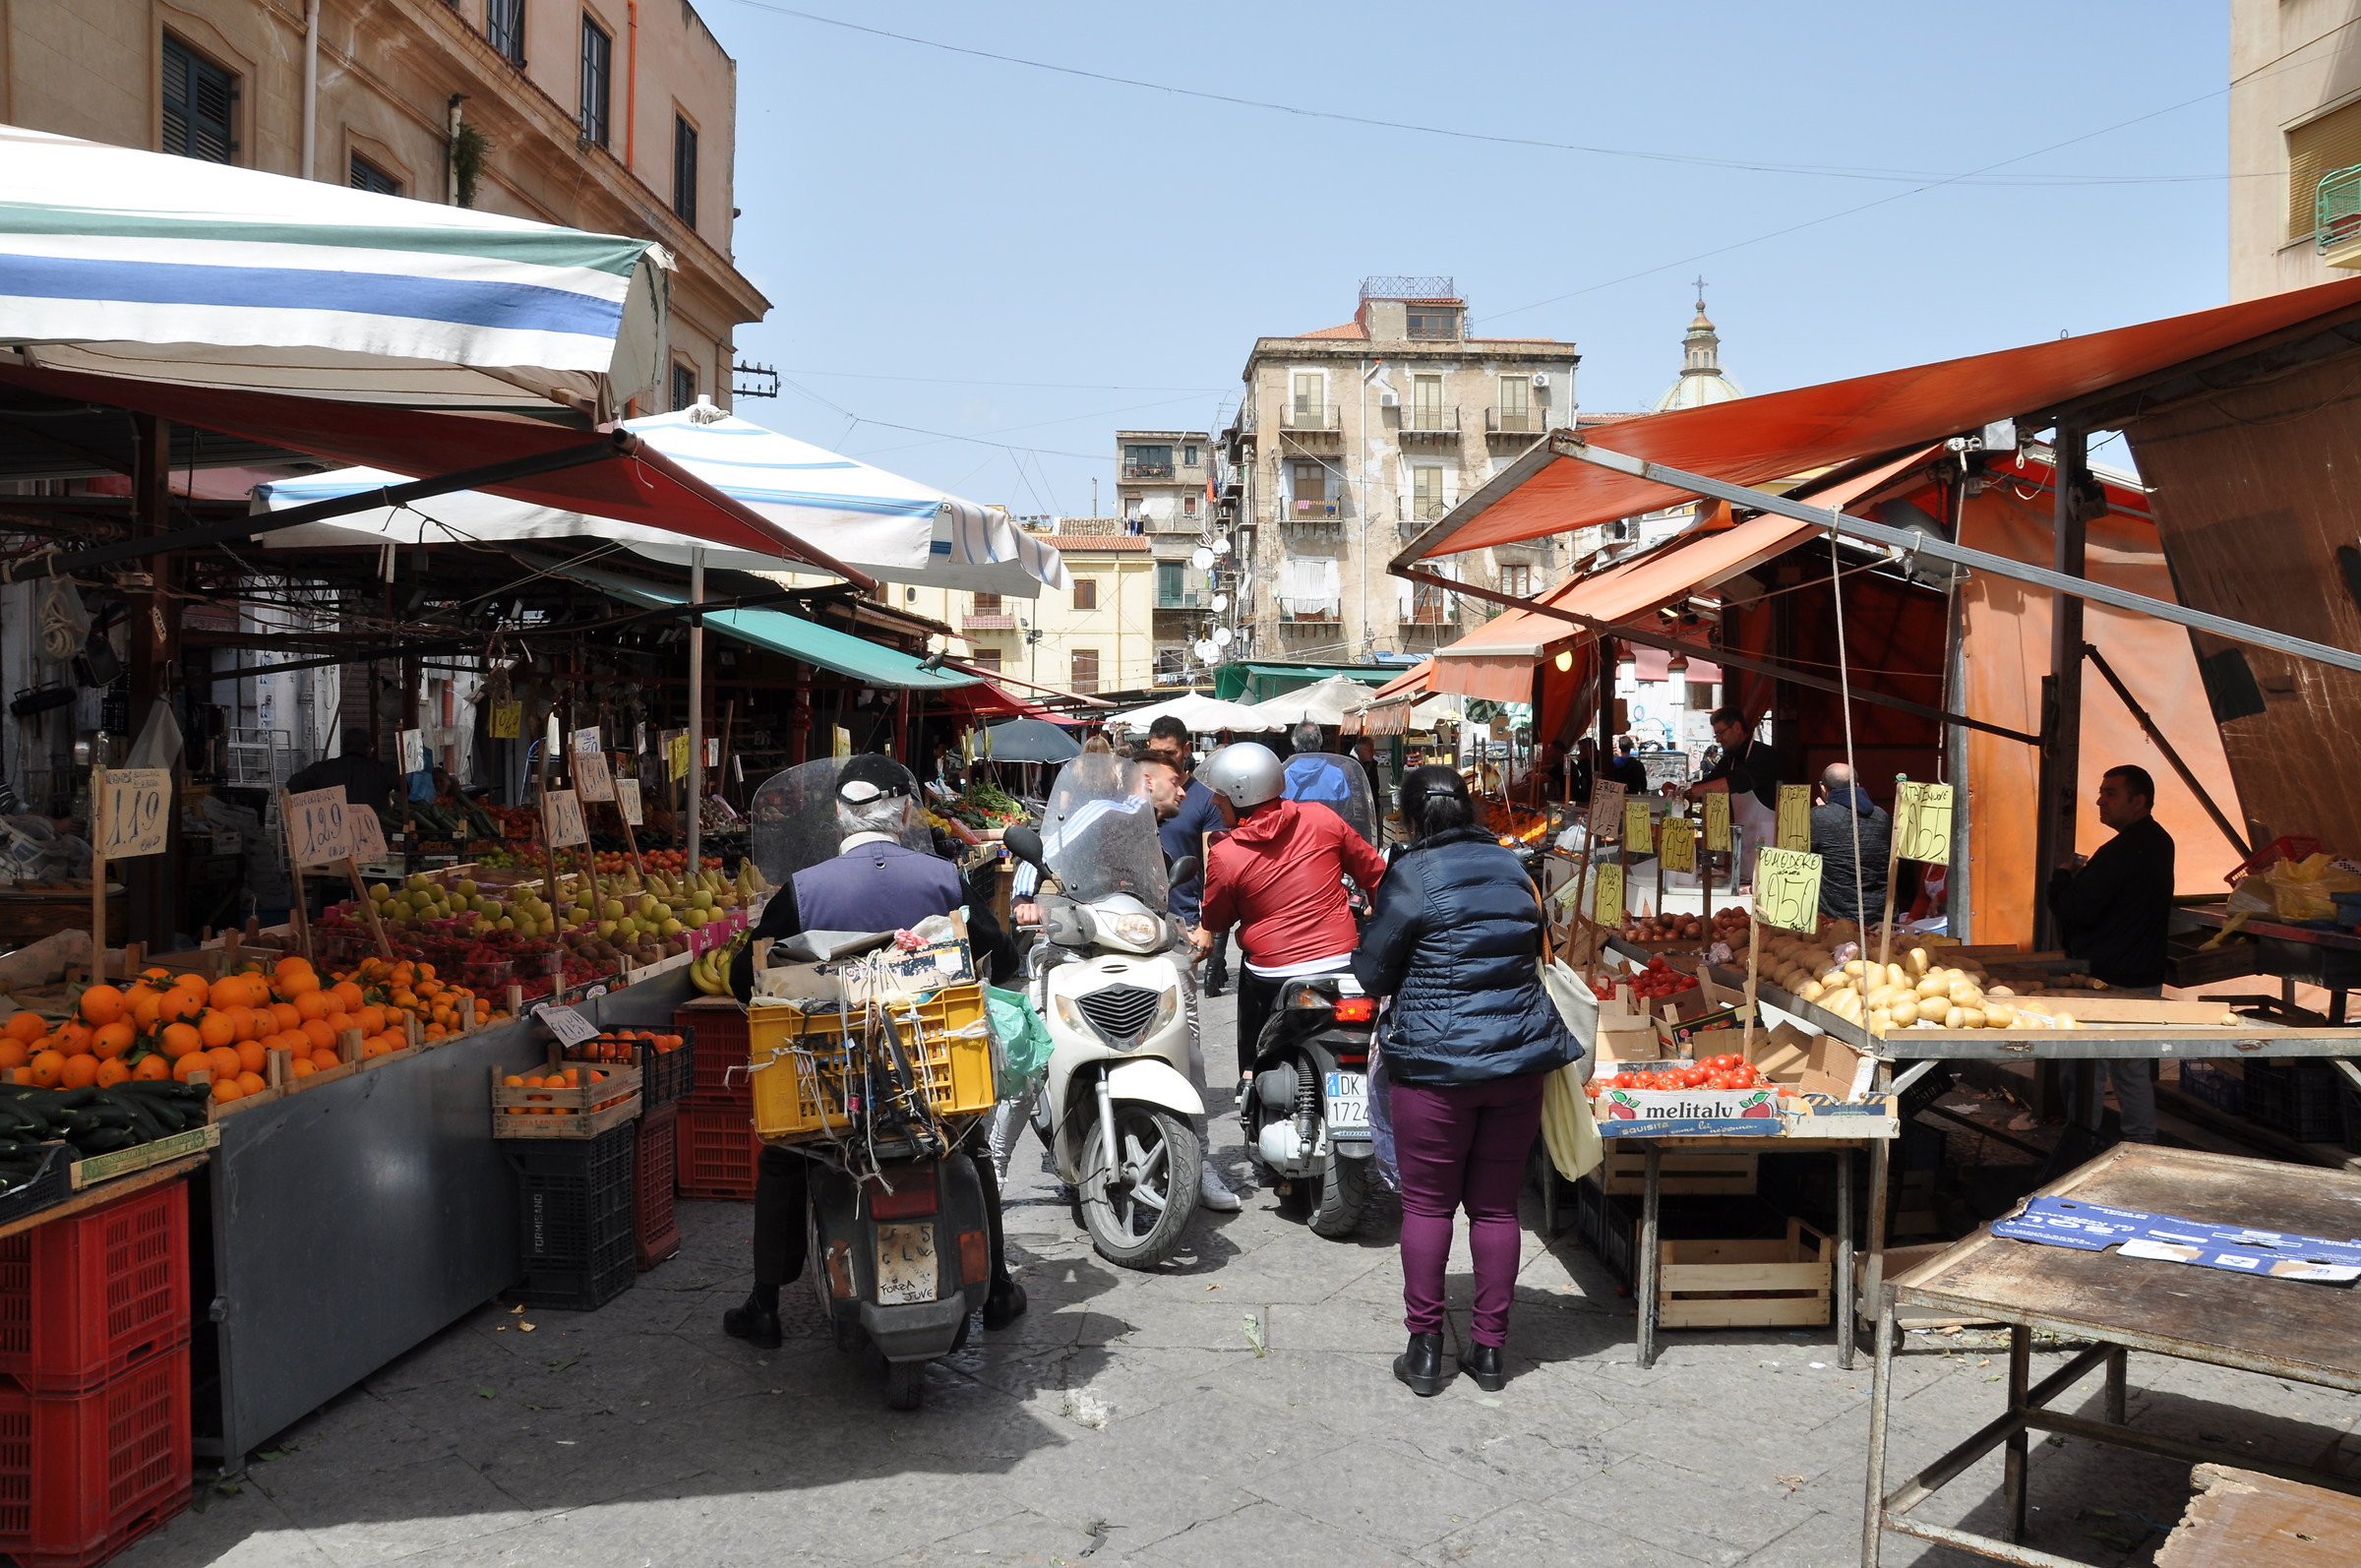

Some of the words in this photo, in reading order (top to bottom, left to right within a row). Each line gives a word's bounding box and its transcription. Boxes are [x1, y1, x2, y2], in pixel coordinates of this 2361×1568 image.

[1341, 1076, 1360, 1095] DK
[880, 1280, 916, 1296] FORZA
[902, 1289, 934, 1301] JUVE
